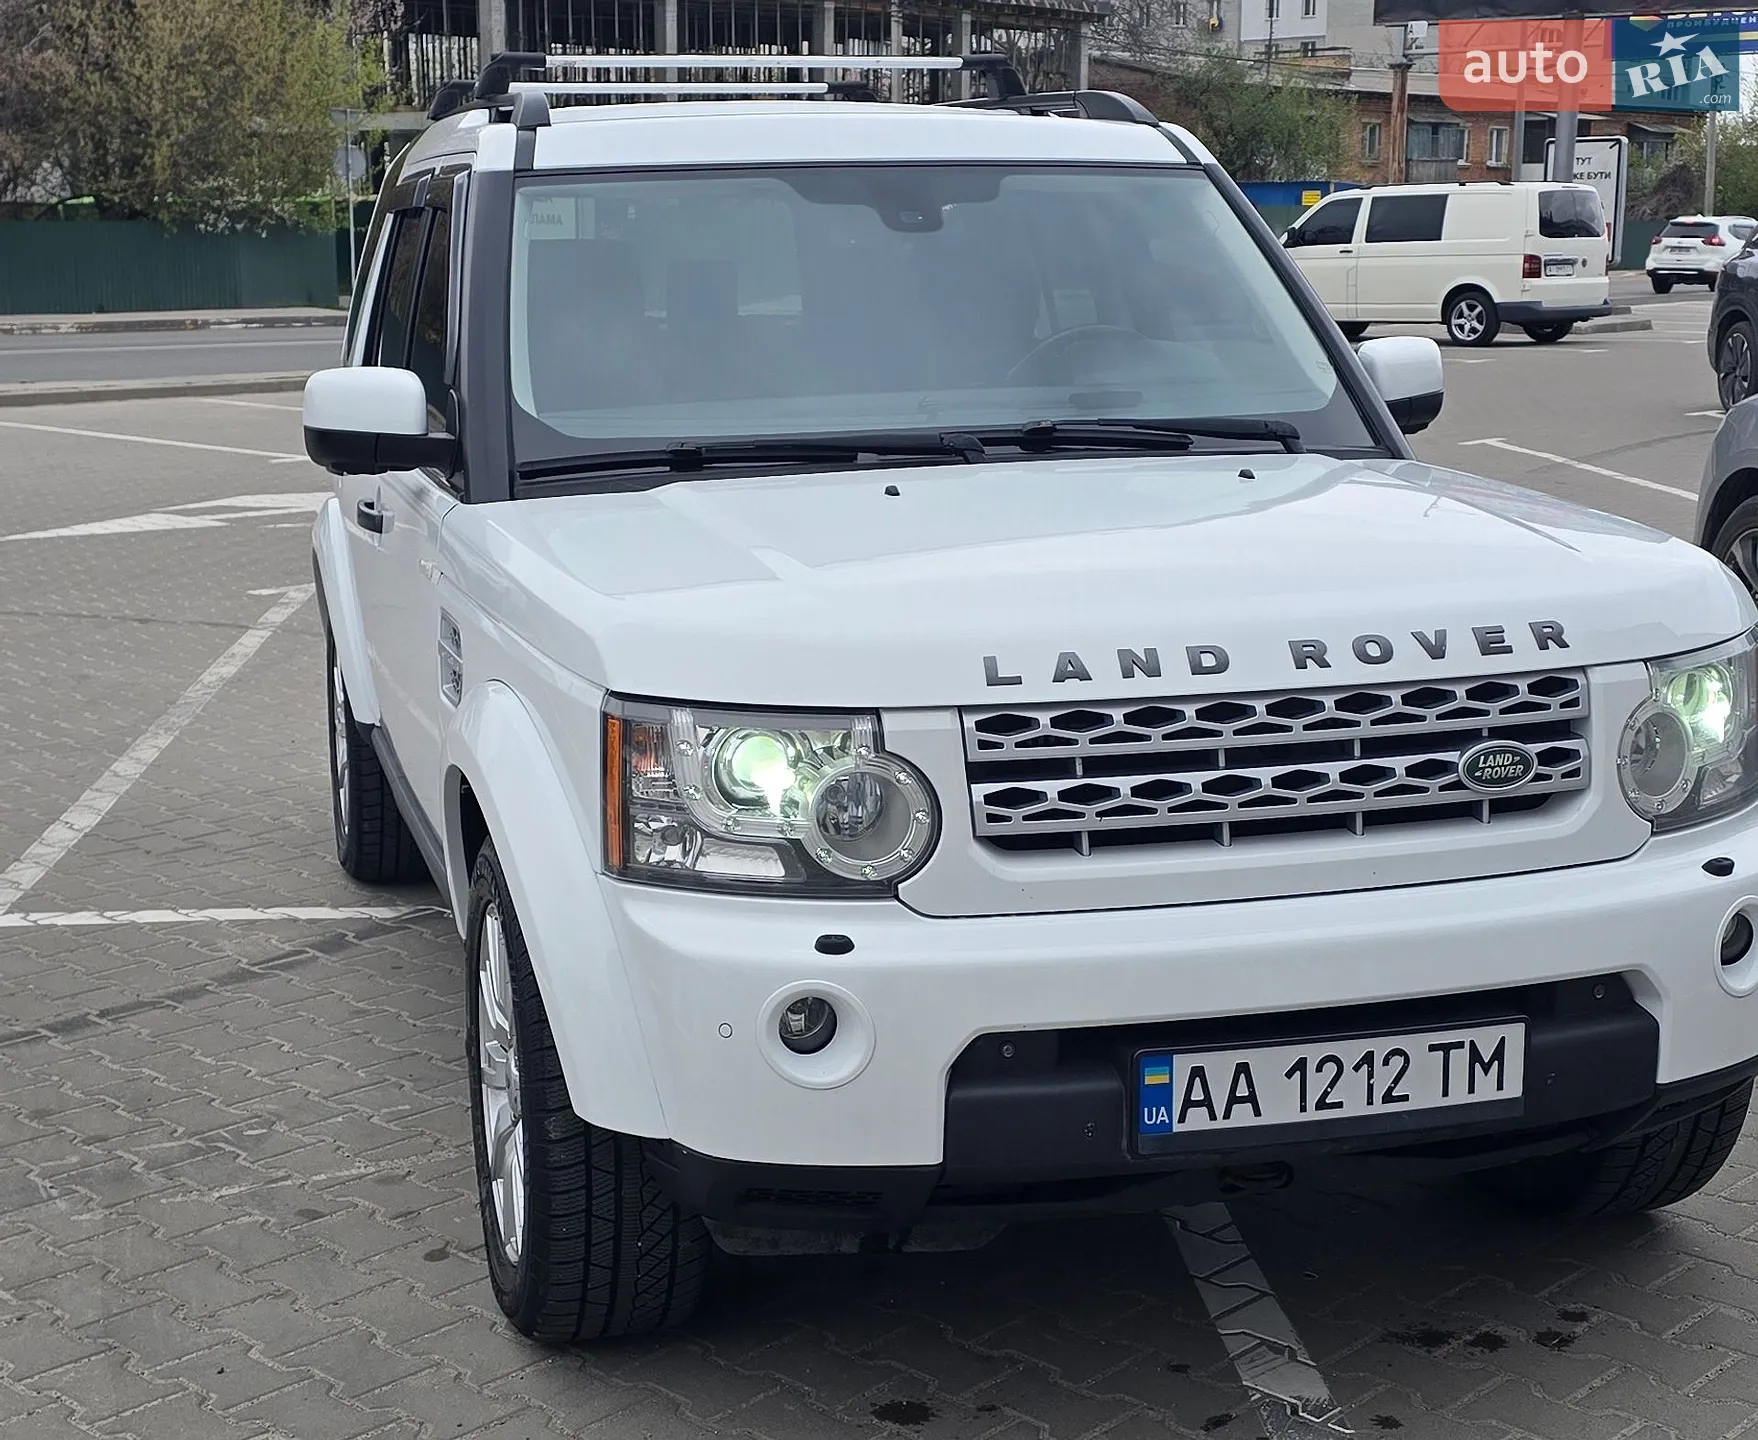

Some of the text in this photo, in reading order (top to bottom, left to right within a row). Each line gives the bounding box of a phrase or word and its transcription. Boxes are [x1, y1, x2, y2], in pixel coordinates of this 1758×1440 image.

[1576, 157, 1592, 166] ТУТ
[1587, 171, 1612, 180] БУТИ
[983, 620, 1571, 687] LAND ROVER
[1479, 753, 1513, 768] LAND
[1482, 765, 1524, 780] ROVER
[1177, 1035, 1507, 1125] AA 1212 TM
[1144, 1107, 1170, 1126] UA
